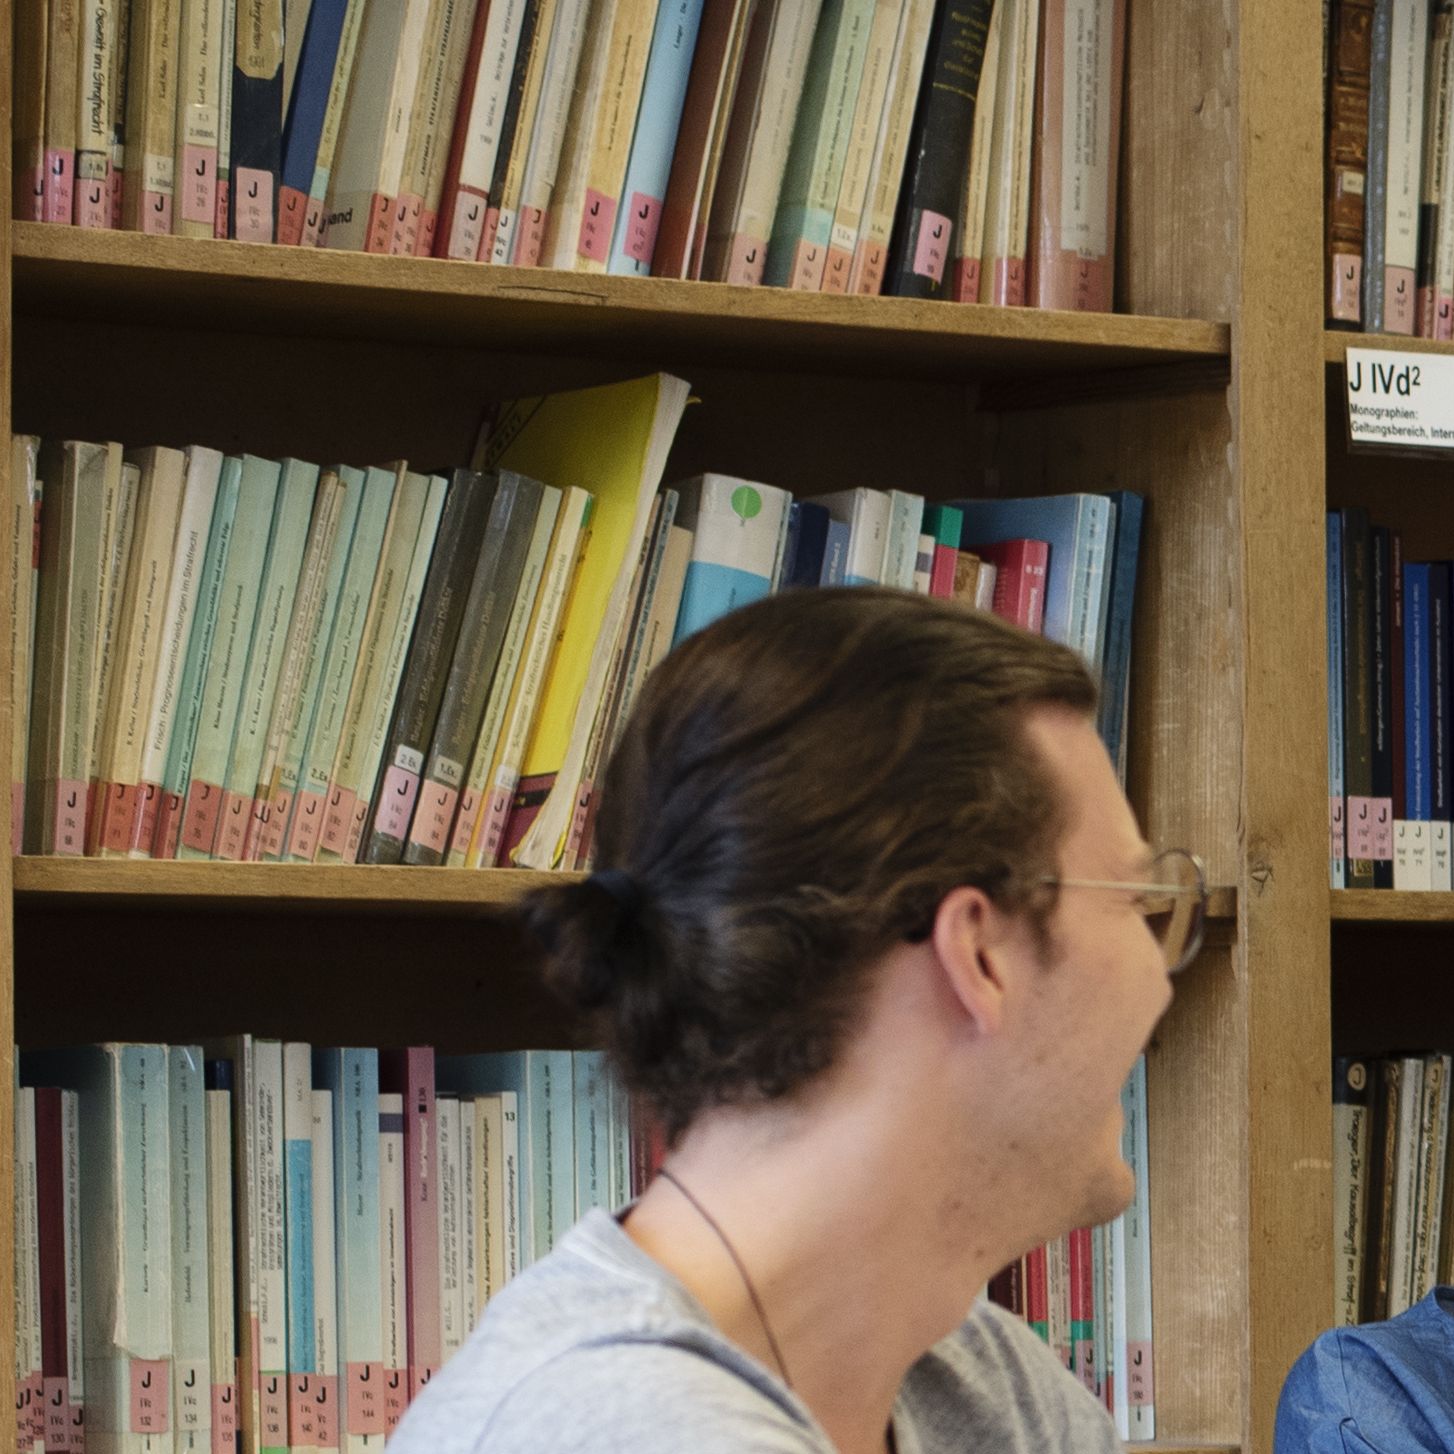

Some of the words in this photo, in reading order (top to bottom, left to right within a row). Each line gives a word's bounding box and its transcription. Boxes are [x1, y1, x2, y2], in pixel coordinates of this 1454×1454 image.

[1350, 361, 1363, 393] J
[1350, 403, 1419, 421] Monographien:
[1351, 419, 1430, 439] Geltungsbereich,
[181, 530, 199, 579] Strafrecht
[505, 1112, 515, 1122] 13
[1134, 1350, 1143, 1366] J
[141, 1370, 151, 1389] J
[184, 1368, 196, 1388] J
[360, 1364, 370, 1382] J
[388, 1372, 399, 1390] J
[267, 1376, 278, 1394] J
[298, 1376, 309, 1393] J
[52, 1388, 63, 1406] J
[221, 1386, 232, 1404] J
[316, 1386, 326, 1404] J
[72, 1408, 84, 1426] J
